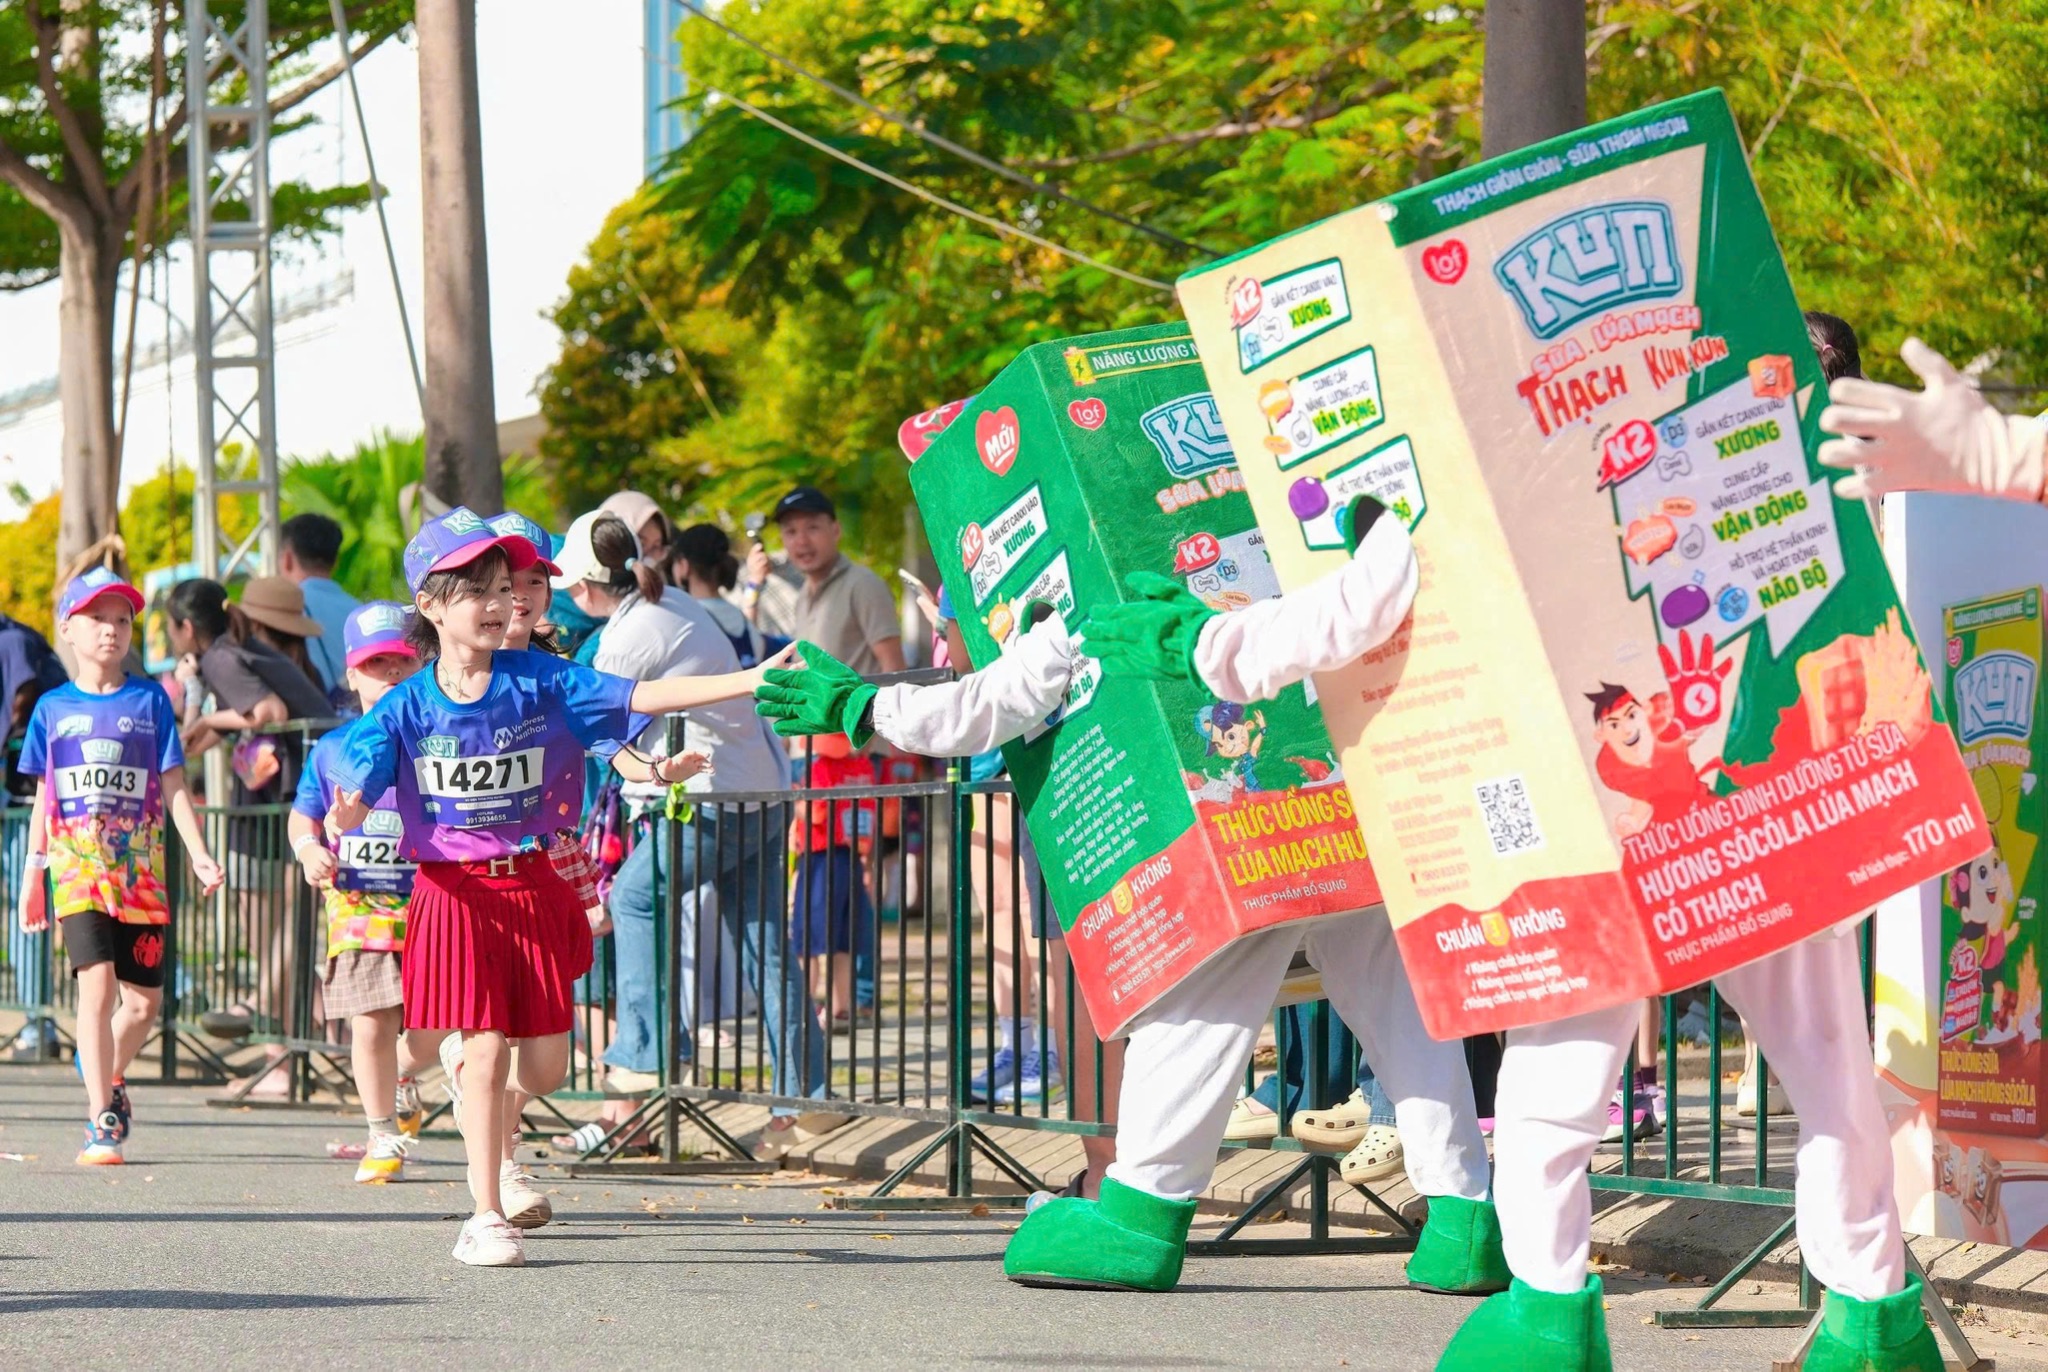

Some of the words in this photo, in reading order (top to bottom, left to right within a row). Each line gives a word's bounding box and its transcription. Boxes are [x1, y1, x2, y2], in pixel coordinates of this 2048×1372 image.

[1432, 185, 1488, 215] THẠCH
[1486, 169, 1525, 195] GIÒN
[1523, 155, 1563, 182] GIÒN
[1567, 142, 1601, 167] SỮA
[1598, 128, 1645, 155] THƠM
[1644, 115, 1690, 142] NGON
[1431, 246, 1462, 272] lof
[1234, 281, 1260, 316] K2
[1092, 351, 1136, 370] NĂNG
[1136, 343, 1189, 364] LƯỢNG
[1532, 338, 1586, 382] SỮA
[1592, 313, 1635, 352] LÚA
[1634, 305, 1701, 336] MẠCH
[1076, 405, 1101, 421] lof
[1517, 364, 1628, 436] THẠCH
[985, 424, 1015, 464] MỚI
[1607, 423, 1652, 470] K2
[1714, 420, 1781, 460] XƯƠNG
[1722, 470, 1751, 488] CUNG
[1750, 461, 1770, 478] CẤP
[1772, 472, 1794, 488] CHO
[1156, 479, 1209, 513] SỮA
[1712, 511, 1753, 542] VẬN
[1754, 489, 1808, 527] ĐỘNG
[988, 531, 1001, 546] GẮN
[1009, 507, 1027, 530] CANXI
[1025, 496, 1038, 516] VÀO
[1003, 520, 1036, 557] XƯƠNG
[1180, 536, 1216, 565] K2
[1223, 564, 1237, 576] D3
[1038, 573, 1051, 594] CẤP
[1053, 579, 1065, 596] CHO
[1758, 574, 1799, 609] NÃO
[1800, 558, 1828, 590] BỘ
[1057, 592, 1072, 616] NG
[1081, 671, 1094, 692] BỘ
[69, 768, 136, 792] 14043
[433, 754, 529, 792] 14271
[1622, 822, 1681, 865] THỨC
[1676, 800, 1733, 843] UỐNG
[1729, 780, 1780, 822] DINH
[1776, 751, 1844, 802] DƯỠNG
[1838, 734, 1869, 772] TỪ
[1866, 722, 1909, 760] SỮA
[1211, 799, 1276, 844] THỨC
[1271, 784, 1336, 832] UỐNG
[1636, 847, 1724, 905] HƯƠNG
[1720, 809, 1813, 869] SÔCÔLA
[1807, 789, 1856, 832] LÚA
[1850, 759, 1920, 812] MẠCH
[1902, 818, 1945, 856] 170
[1944, 803, 1976, 839] ml
[1226, 845, 1274, 888] LÚA
[1268, 835, 1333, 879] MẠCH
[1082, 899, 1114, 940] CHUẨN
[1130, 856, 1172, 898] KHÔNG
[1243, 894, 1272, 911] THỰC
[1271, 885, 1303, 904] PHẨM
[1318, 879, 1347, 894] SUNG
[1652, 899, 1689, 942] CÓ
[1685, 873, 1768, 928] THẠCH
[1435, 917, 1485, 953] CHUẨN
[1508, 908, 1567, 938] KHÔNG
[1664, 941, 1702, 966] THỰC
[1700, 922, 1740, 951] PHẨM
[1757, 903, 1794, 928] SUNG
